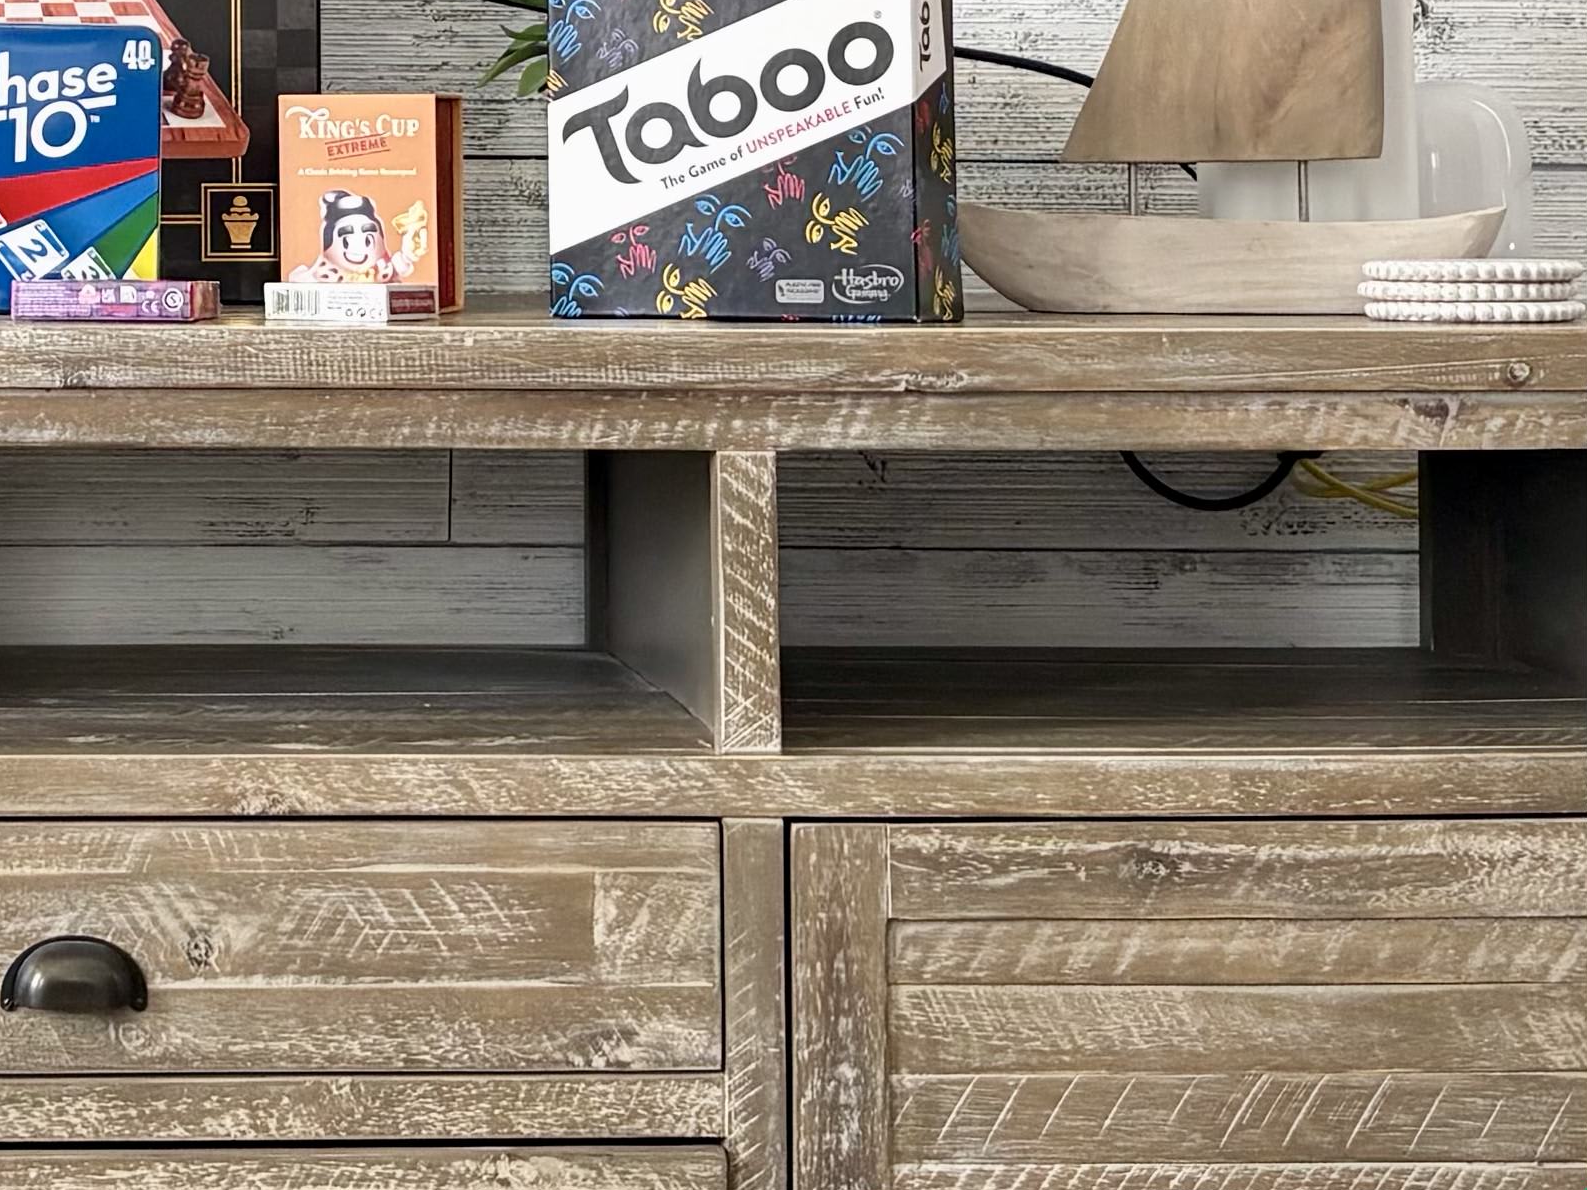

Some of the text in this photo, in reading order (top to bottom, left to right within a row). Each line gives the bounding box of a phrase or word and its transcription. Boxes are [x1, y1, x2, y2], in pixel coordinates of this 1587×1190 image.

[285, 105, 420, 139] KING'S CUP
[562, 20, 895, 185] Taboo
[7, 99, 88, 163] 10
[326, 137, 388, 157] EXTREME
[660, 87, 886, 190] The Game of UNSPEAKABLE Fun!
[834, 268, 900, 289] Hasbro
